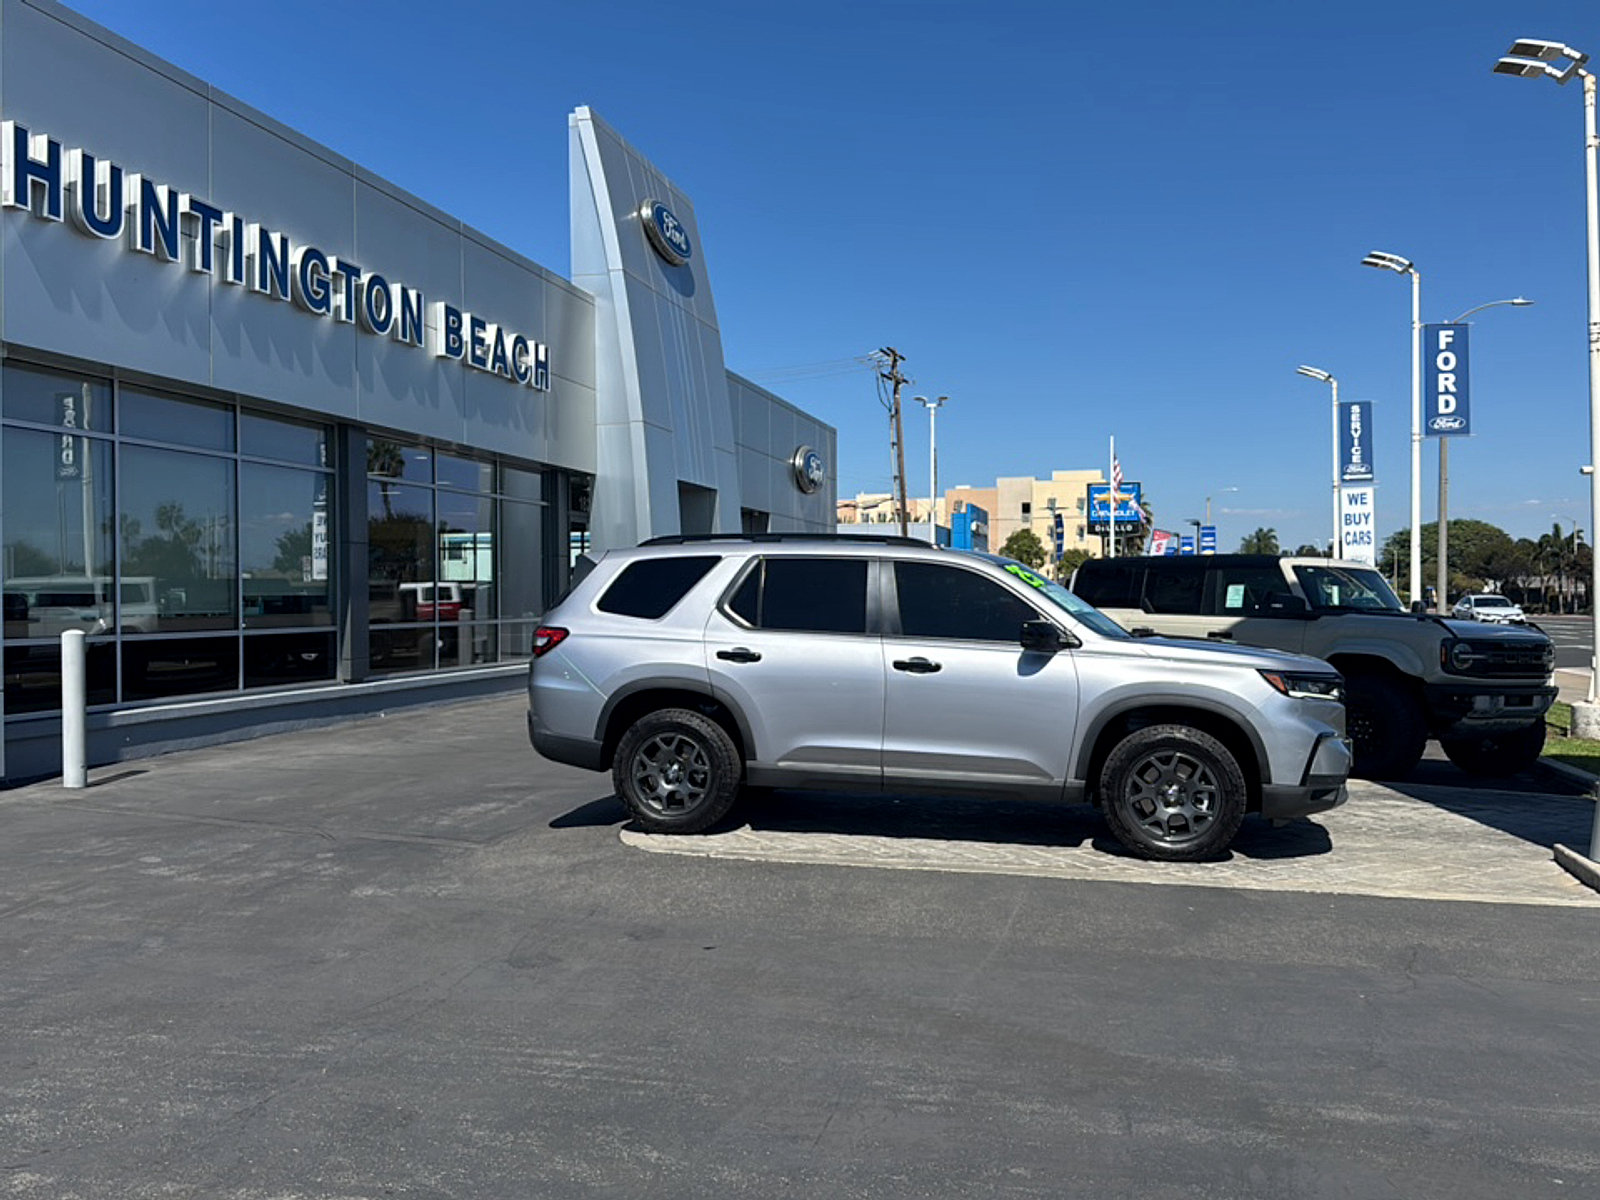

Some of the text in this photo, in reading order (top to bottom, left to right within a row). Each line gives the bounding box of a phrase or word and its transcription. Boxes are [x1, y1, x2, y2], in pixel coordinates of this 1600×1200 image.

[663, 211, 687, 250] Ford
[2, 120, 551, 392] HUNTINGTON BEACH
[1436, 330, 1457, 414] FORD
[1350, 405, 1361, 463] SERVICE
[1433, 416, 1461, 430] Ford
[1347, 493, 1367, 505] WE
[1344, 513, 1371, 526] BUY
[1345, 531, 1372, 546] CARS
